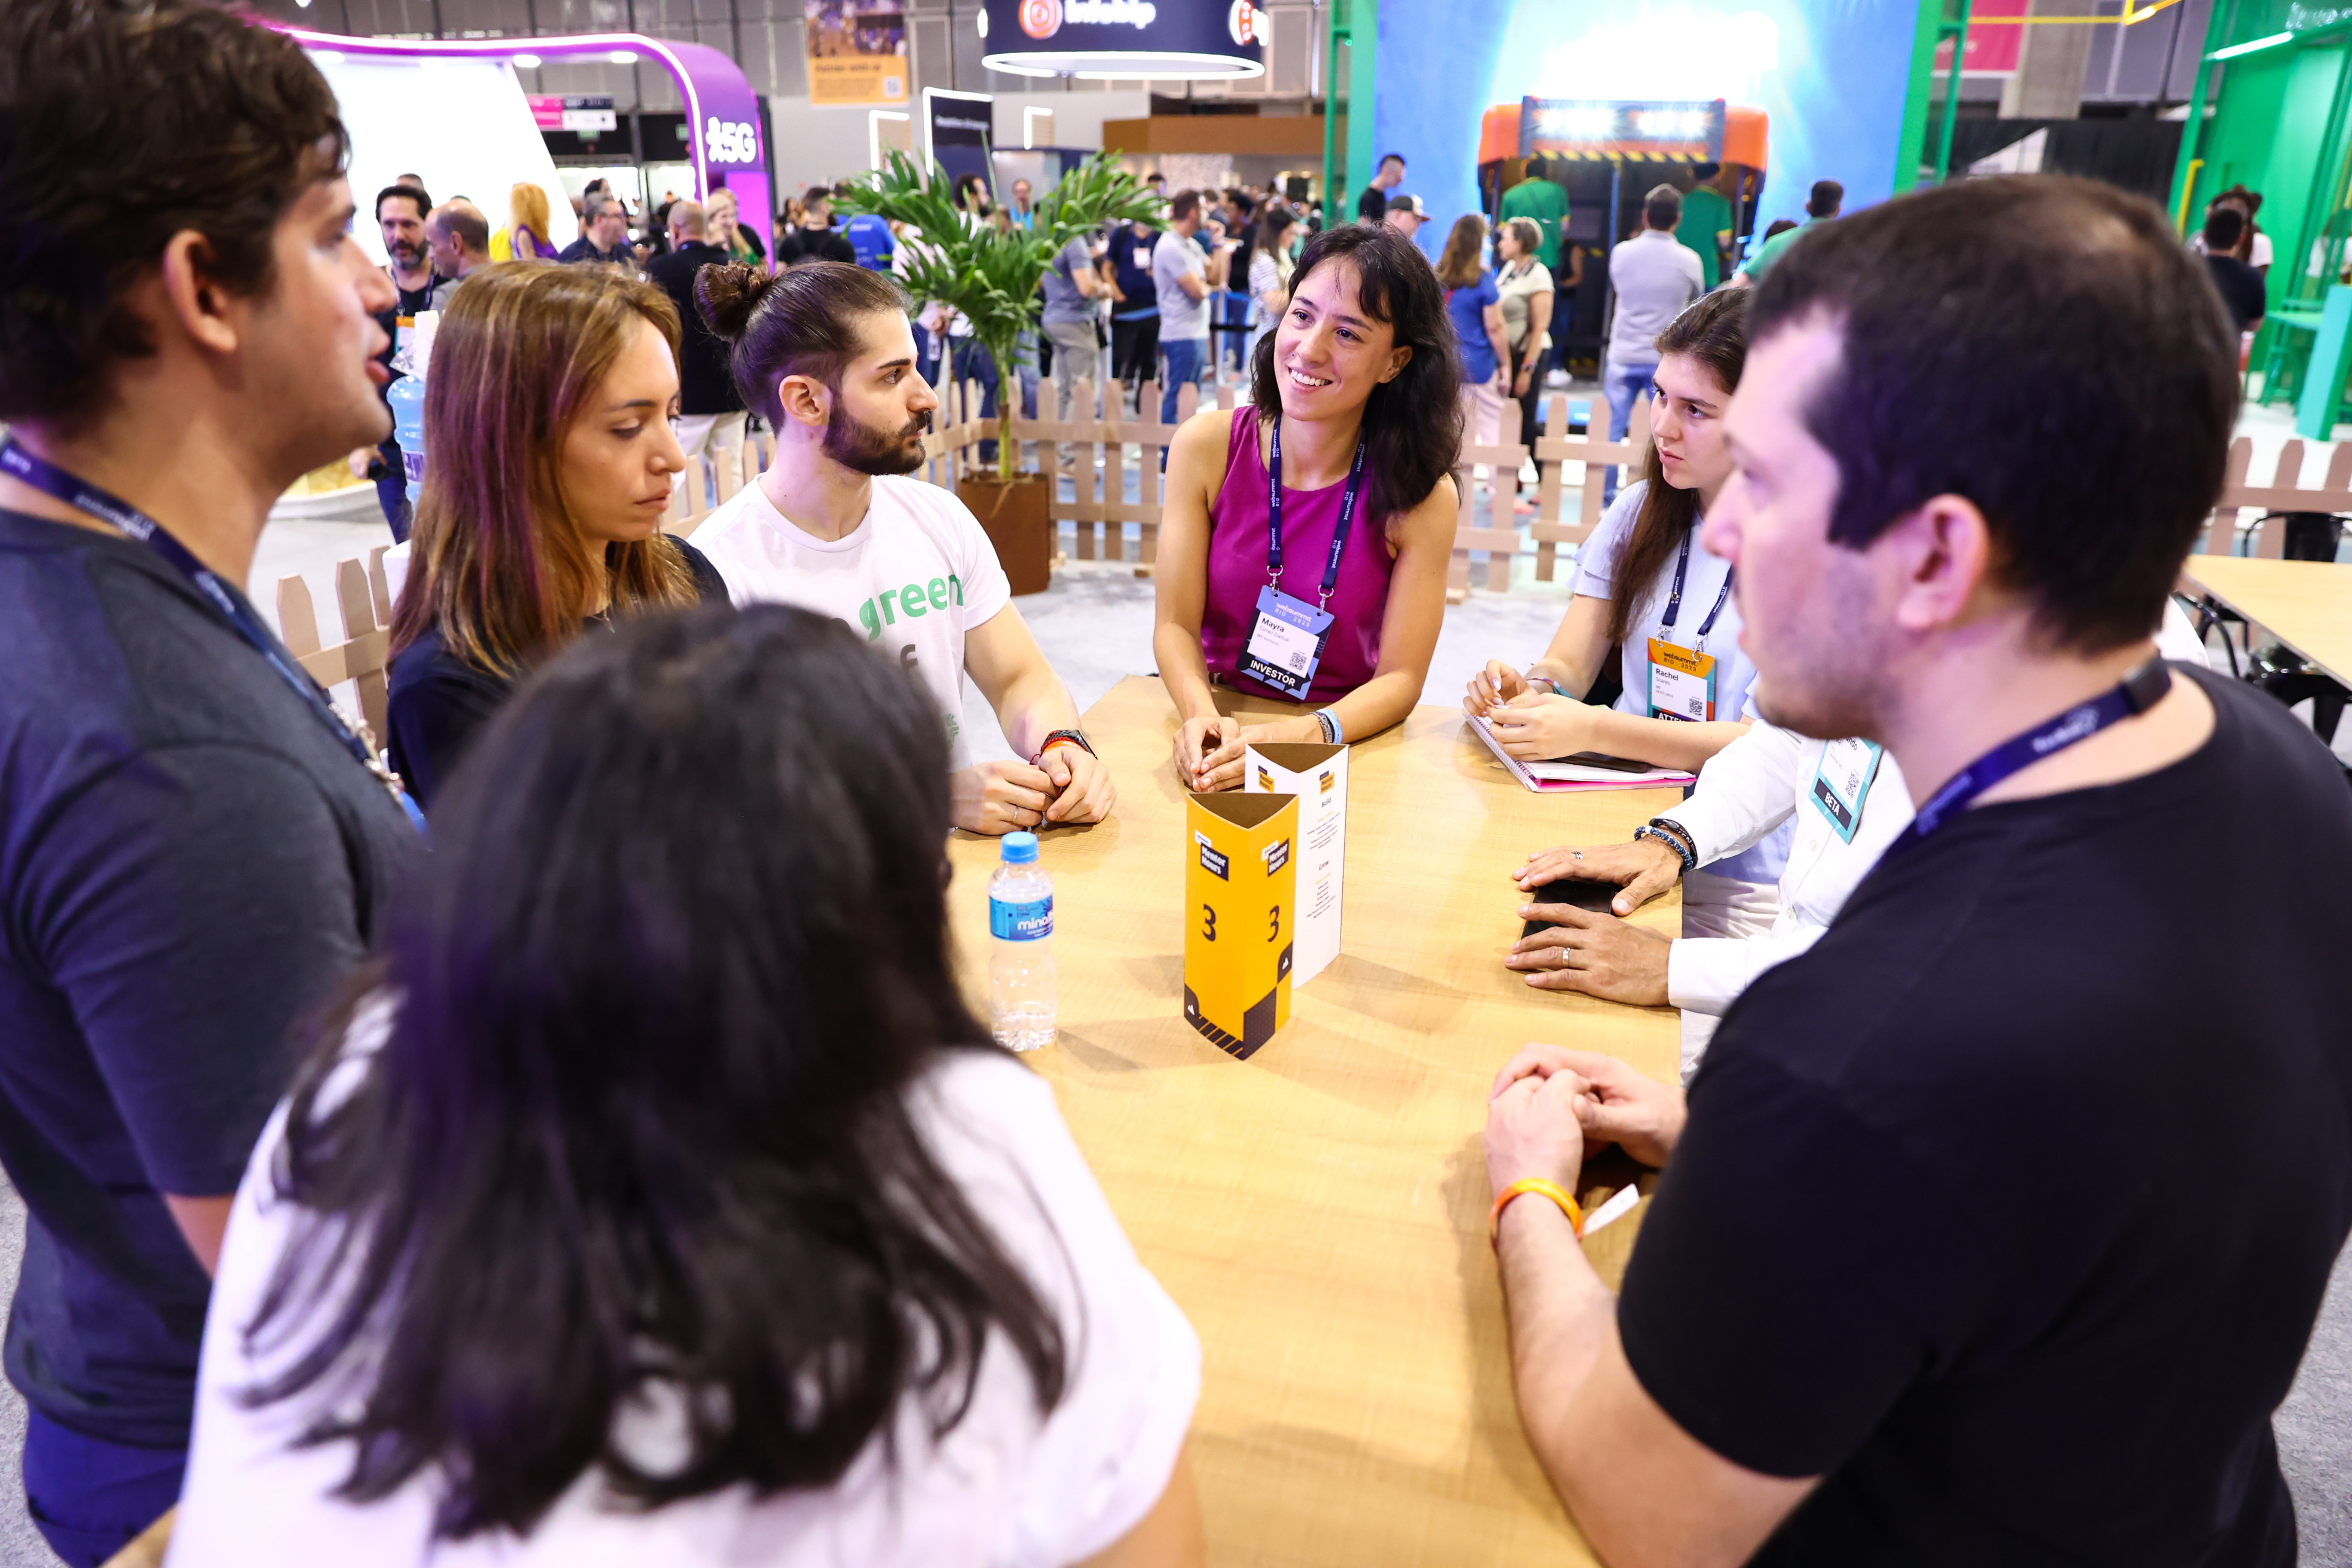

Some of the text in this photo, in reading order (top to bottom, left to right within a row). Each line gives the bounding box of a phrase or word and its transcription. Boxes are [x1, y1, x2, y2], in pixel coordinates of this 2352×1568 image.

[1343, 492, 1354, 521] websummit
[1331, 540, 1341, 569] websummit
[859, 574, 964, 642] green
[1274, 608, 1311, 628] RIO 2023
[1276, 603, 1313, 623] websummit
[1262, 618, 1285, 633] Mayra
[1250, 659, 1296, 687] INVESTOR
[1656, 668, 1678, 681] Rachel
[1681, 662, 1697, 672] 2023
[1658, 712, 1686, 722] ATTE
[1825, 792, 1840, 816] BETA
[1201, 845, 1226, 868] Mentor
[1269, 843, 1289, 864] Mentor
[1201, 855, 1222, 875] Hours
[1268, 855, 1285, 874] Hours
[1201, 903, 1216, 942] 3
[1268, 904, 1280, 943] 3
